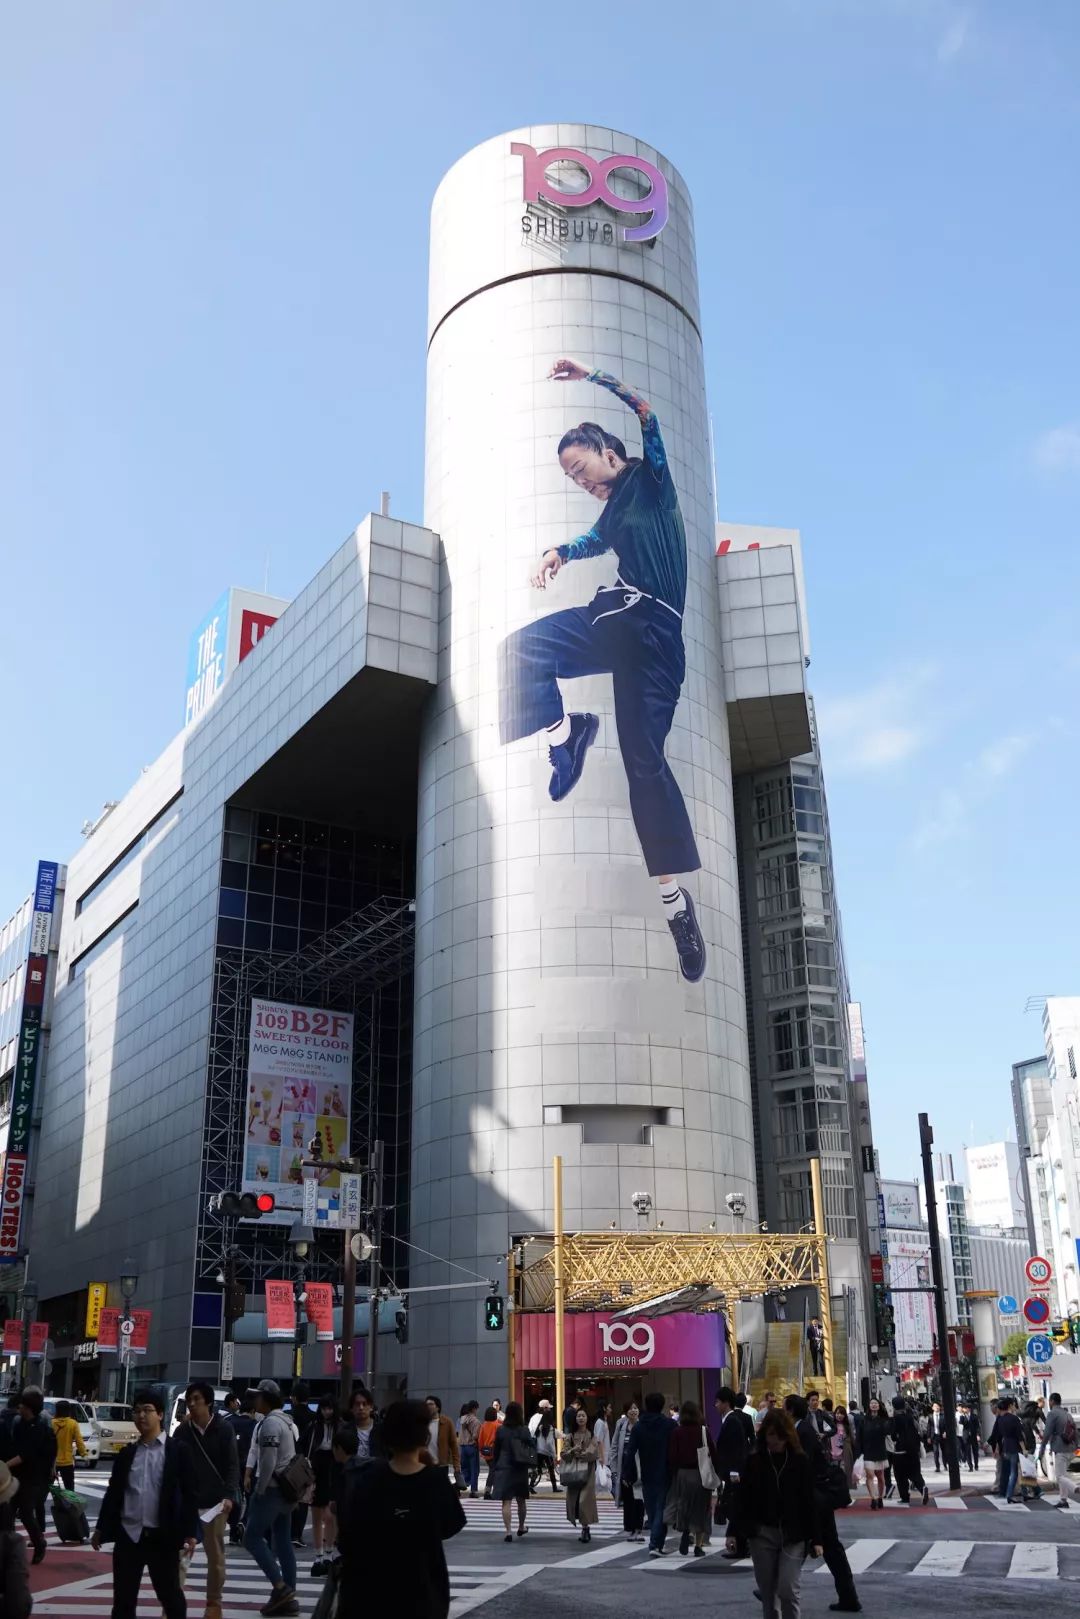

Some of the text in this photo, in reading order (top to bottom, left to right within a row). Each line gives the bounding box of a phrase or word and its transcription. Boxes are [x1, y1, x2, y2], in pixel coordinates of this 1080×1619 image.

[511, 142, 669, 242] 109
[521, 215, 614, 241] SHIBUYA
[197, 616, 220, 676] THE
[37, 868, 54, 910] THE PRIME
[41, 913, 49, 933] LIVING
[256, 1004, 289, 1015] SHIBUYA
[256, 1009, 351, 1038] 109 B2F
[253, 1030, 350, 1051] SWEETS FLOOR
[13, 1144, 24, 1152] 3F
[1, 1162, 25, 1248] HOOTERS
[1031, 1264, 1046, 1277] 30
[123, 1322, 131, 1332] 4
[598, 1321, 655, 1365] 109
[1032, 1342, 1044, 1360] P
[603, 1356, 637, 1366] SHIBUYA
